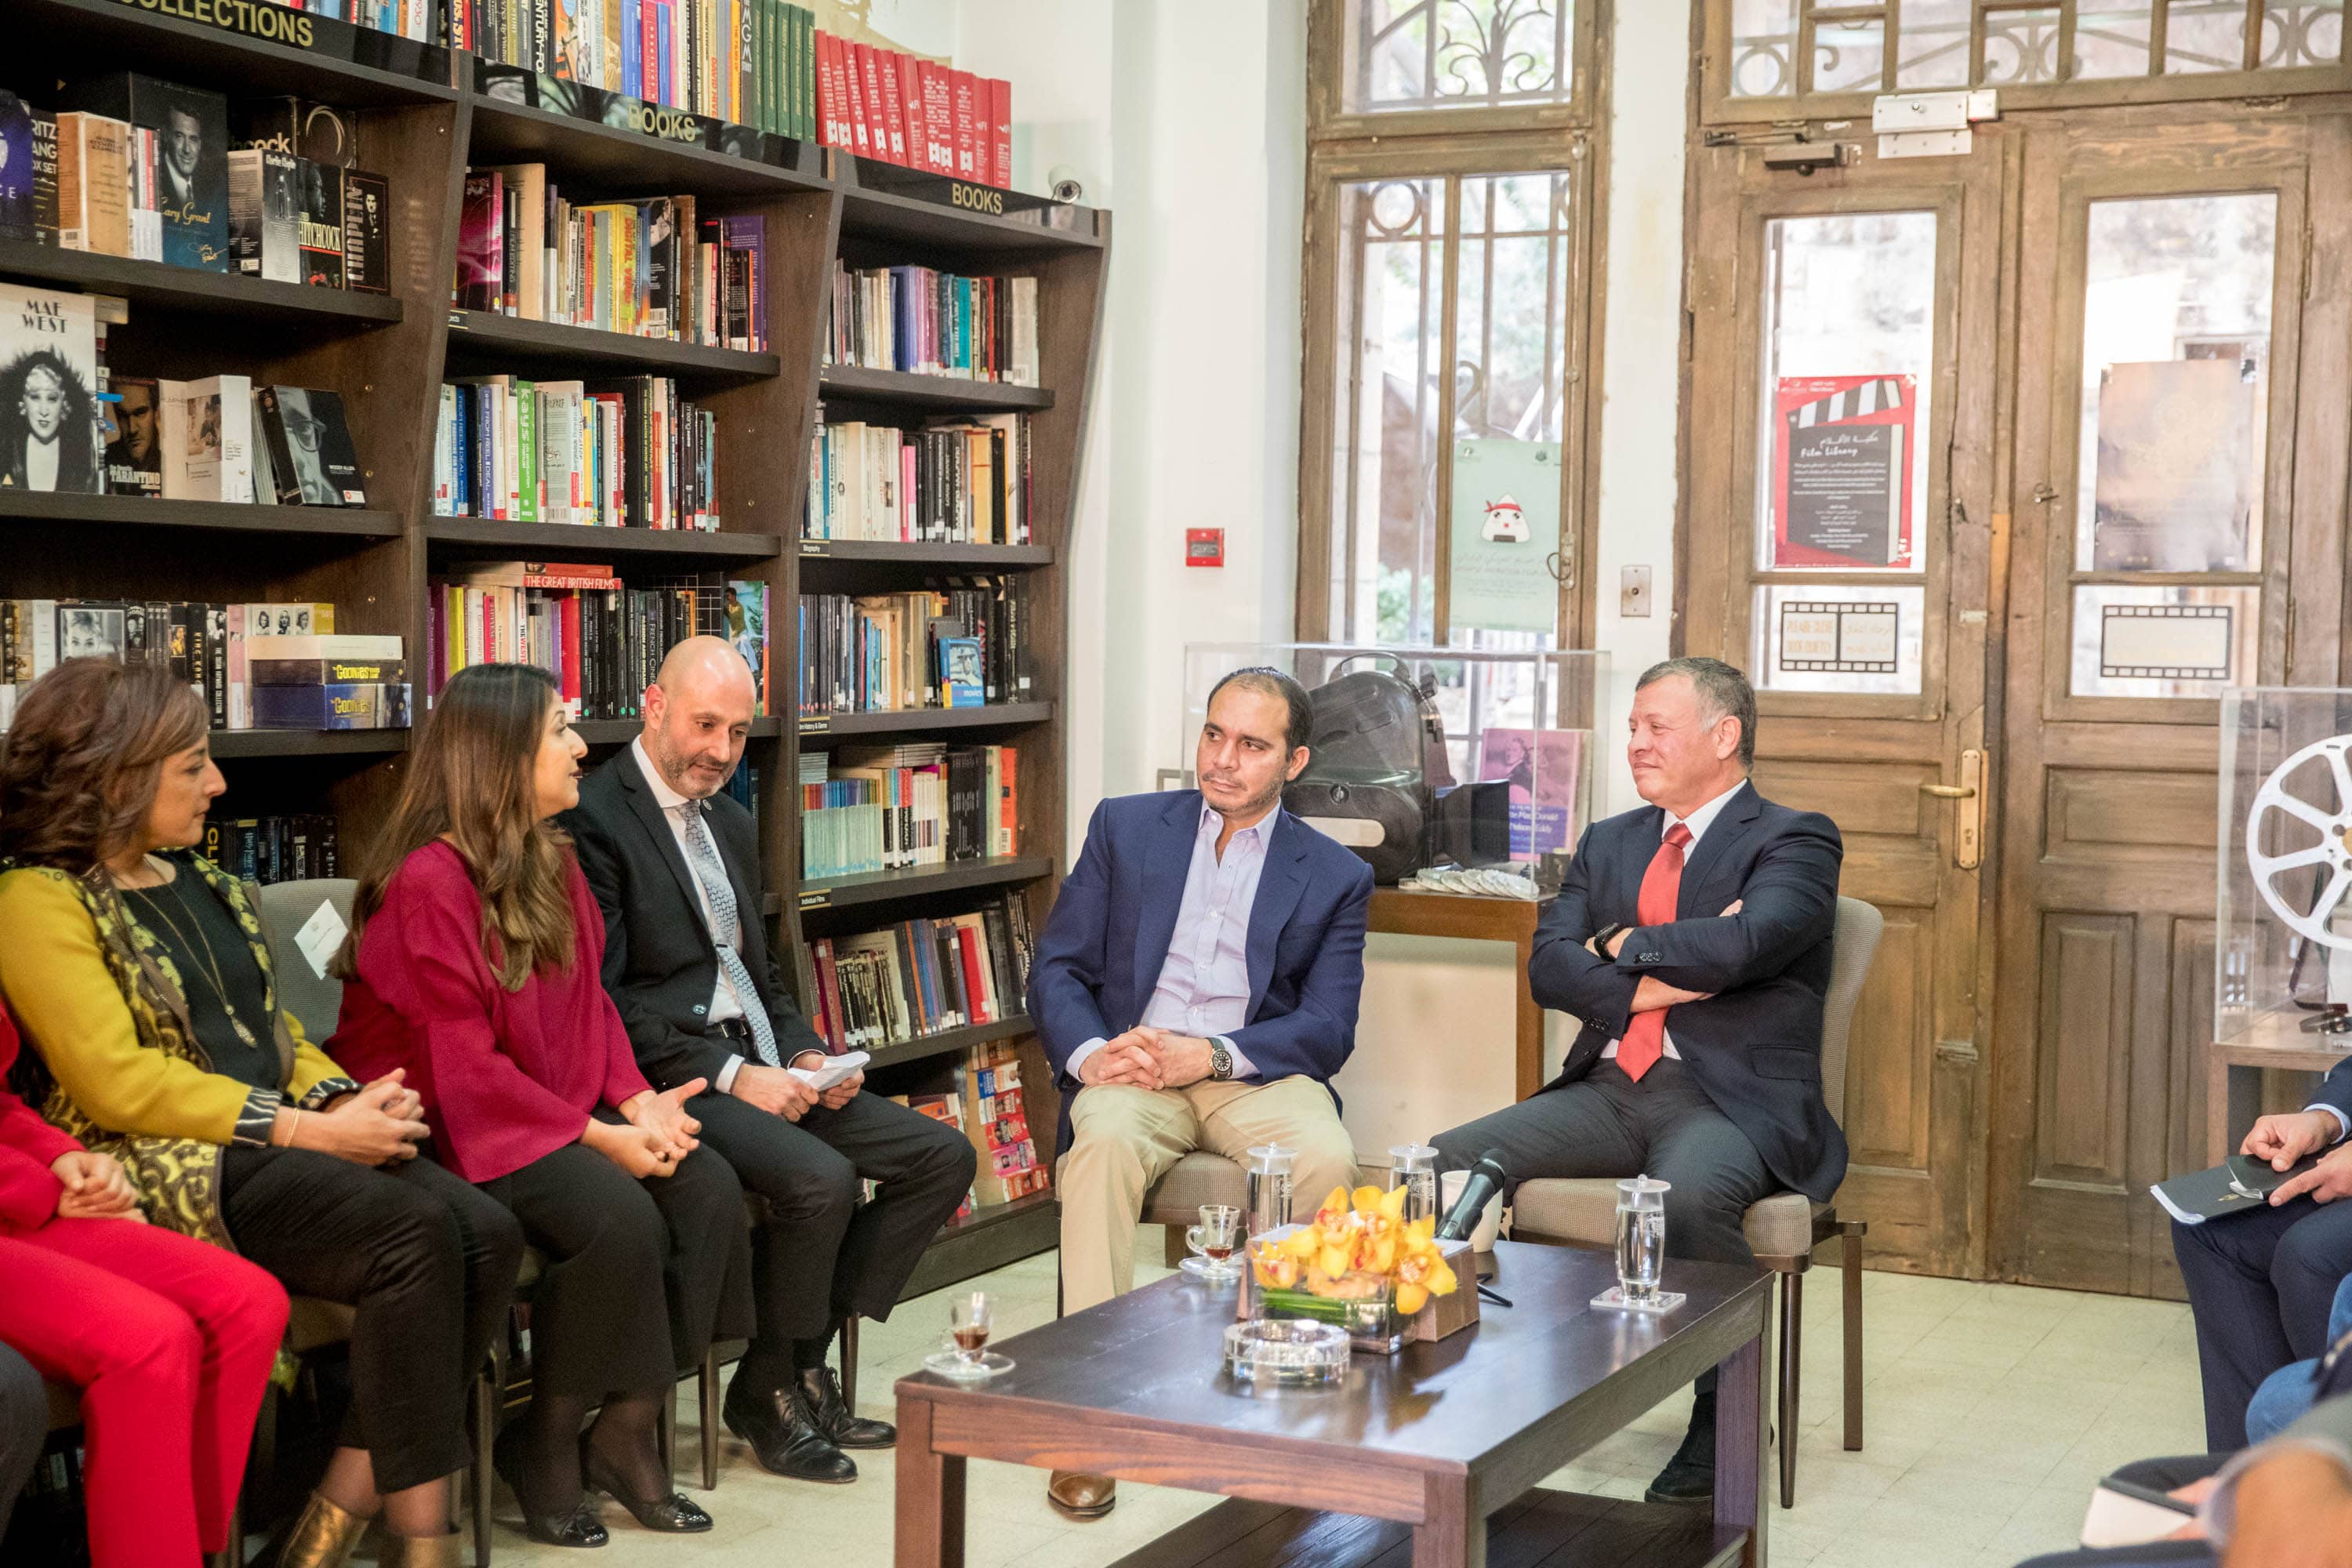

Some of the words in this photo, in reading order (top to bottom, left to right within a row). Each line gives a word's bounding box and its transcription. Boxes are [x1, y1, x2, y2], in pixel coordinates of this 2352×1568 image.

[32, 119, 56, 140] RITZ
[628, 103, 695, 143] BOOKS
[32, 143, 57, 159] ANG
[32, 162, 42, 172] OX
[43, 162, 57, 174] SET
[952, 182, 1003, 215] BOOKS
[299, 220, 342, 252] HITCHCOCK
[624, 217, 633, 263] DIGITAL
[24, 299, 63, 318] MAE
[22, 313, 69, 334] WEST
[520, 388, 532, 441] kays
[684, 405, 693, 430] mixing
[526, 575, 541, 588] THE
[541, 575, 566, 588] GREAT
[568, 576, 593, 590] BRITISH
[595, 578, 615, 590] FILMS
